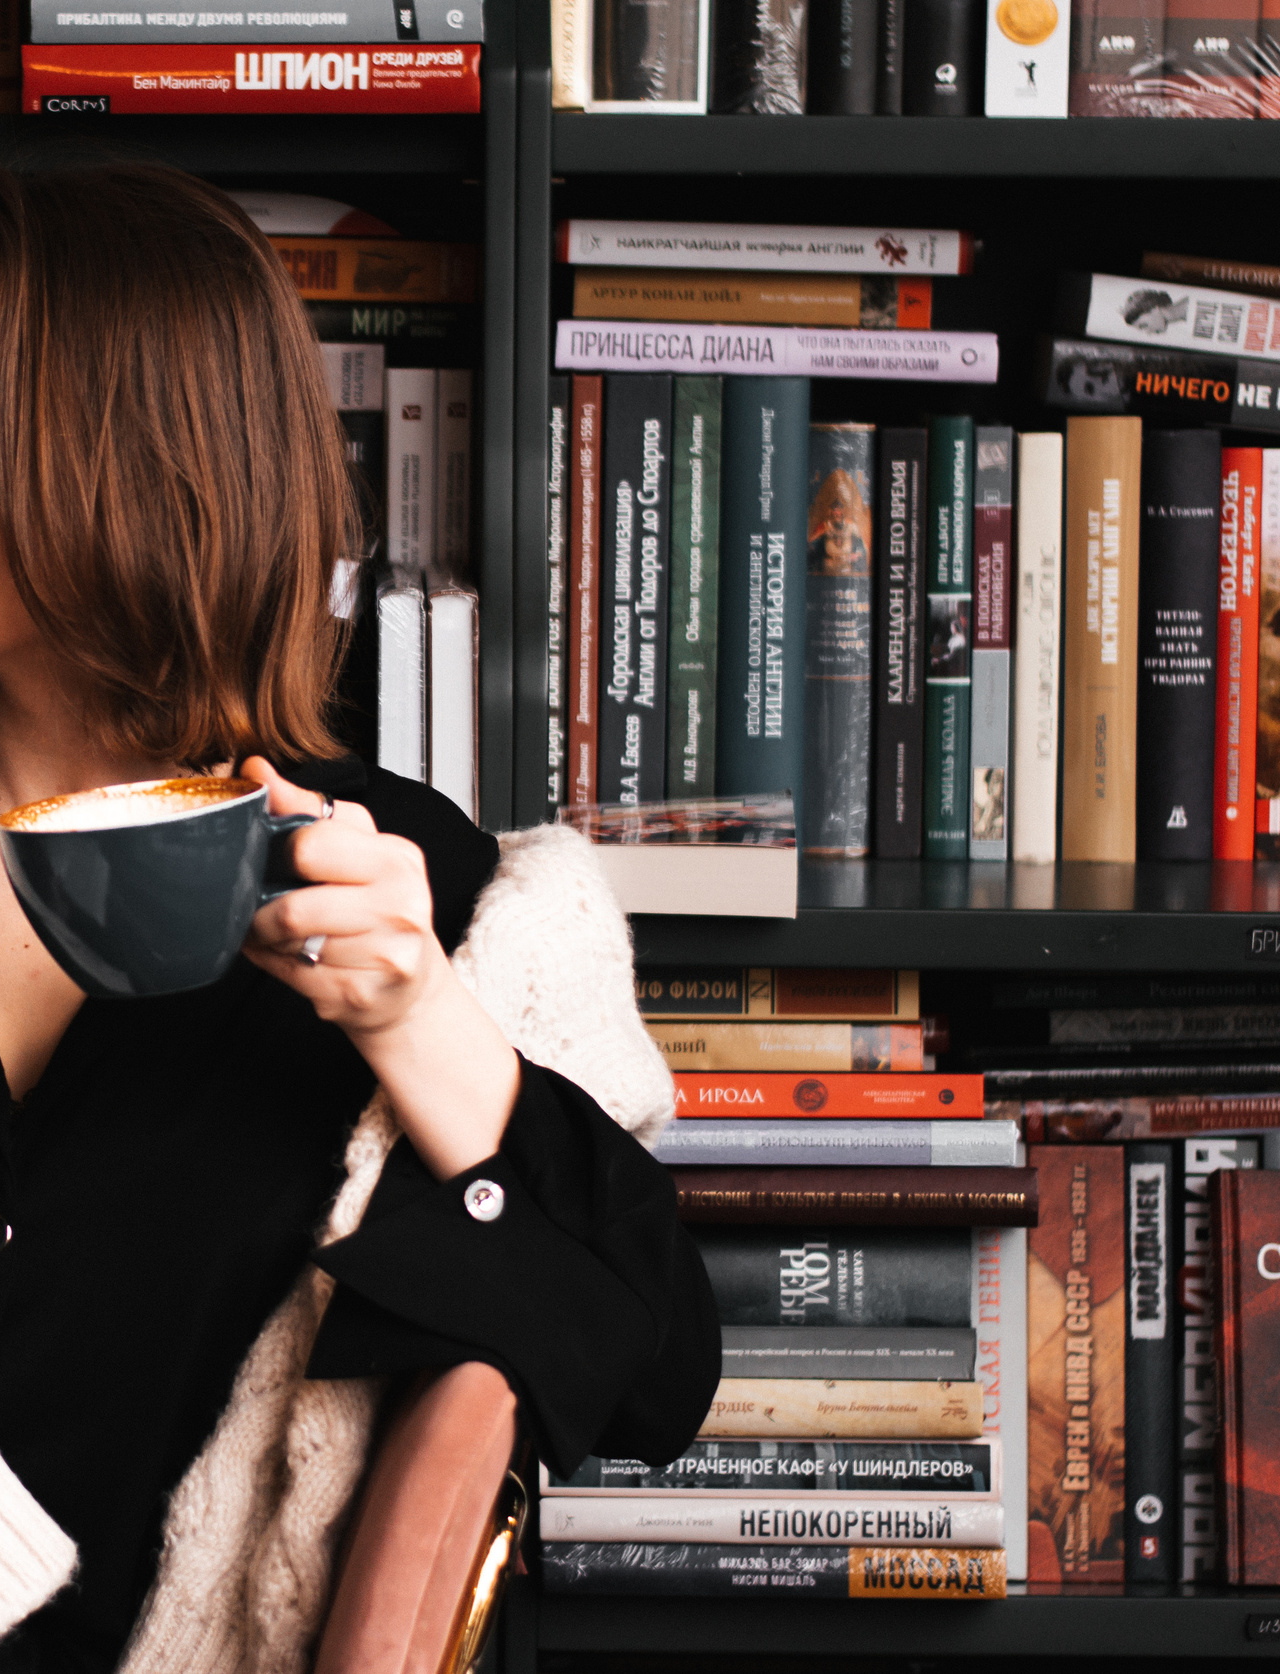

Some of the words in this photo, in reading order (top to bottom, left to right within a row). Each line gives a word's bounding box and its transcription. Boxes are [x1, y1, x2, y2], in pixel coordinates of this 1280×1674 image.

[57, 13, 142, 27] ПРИБАЛТИКА
[146, 13, 195, 27] МЕЖДУ
[197, 13, 243, 28] ДВУМЯ
[247, 13, 348, 27] РЕВОЛЮЦИЯМИ
[234, 52, 369, 91] ШПИОН
[372, 52, 413, 66] СРЕДИ
[415, 48, 464, 67] ДРУЗЕЙ
[133, 75, 157, 91] Бен
[160, 75, 231, 93] Макинтайр
[807, 242, 865, 256] АНГЛИИ
[350, 307, 408, 337] МИР
[569, 331, 695, 361] ПРИНЦЕССА
[700, 335, 775, 364] ДИАНА
[1135, 370, 1231, 404] НИЧЕГО
[1237, 381, 1272, 410] НЕ
[689, 412, 704, 454] Англии
[636, 416, 666, 505] Стюартов
[891, 459, 907, 520] ВРЕМЯ
[640, 507, 660, 532] до
[937, 504, 950, 550] ДВОРЕ
[748, 533, 760, 547] и
[890, 522, 907, 557] ЕГО
[1218, 470, 1239, 613] ЧЕСТЕРТОН
[634, 534, 664, 613] Тюдоров
[689, 545, 703, 592] городов
[764, 531, 784, 640] ИСТОРИЯ
[890, 562, 905, 580] И
[937, 552, 950, 584] ПРИ
[747, 550, 764, 666] английского
[977, 554, 991, 625] ПОИСКАХ
[991, 541, 1005, 640] РАВНОВЕСИЯ
[640, 616, 656, 638] от
[887, 586, 907, 704] КЛАРЕНДОН
[977, 629, 990, 640] В
[633, 641, 656, 707] Англии
[763, 641, 782, 739] АНГЛИИ
[742, 670, 761, 737] народа
[620, 712, 640, 767] Евсеев
[620, 771, 640, 803] В.А.
[697, 1087, 766, 1104] ИРОДА
[690, 1190, 751, 1208] ИСТОРИИ
[967, 1192, 1025, 1210] МОСКВЫ
[1130, 1174, 1163, 1321] МАЙДАНЕК
[1066, 1269, 1092, 1331] СССР
[1065, 1334, 1093, 1401] НКВД
[776, 1459, 825, 1475] КАФЕ
[852, 1460, 974, 1480] ШИНДЛЕРОВ»
[739, 1505, 953, 1539] НЕПОКОРЕННЫЙ
[731, 1574, 768, 1586] НИСИМ
[770, 1574, 817, 1587] МИШАЛЬ
[862, 1556, 986, 1593] МОССАД
